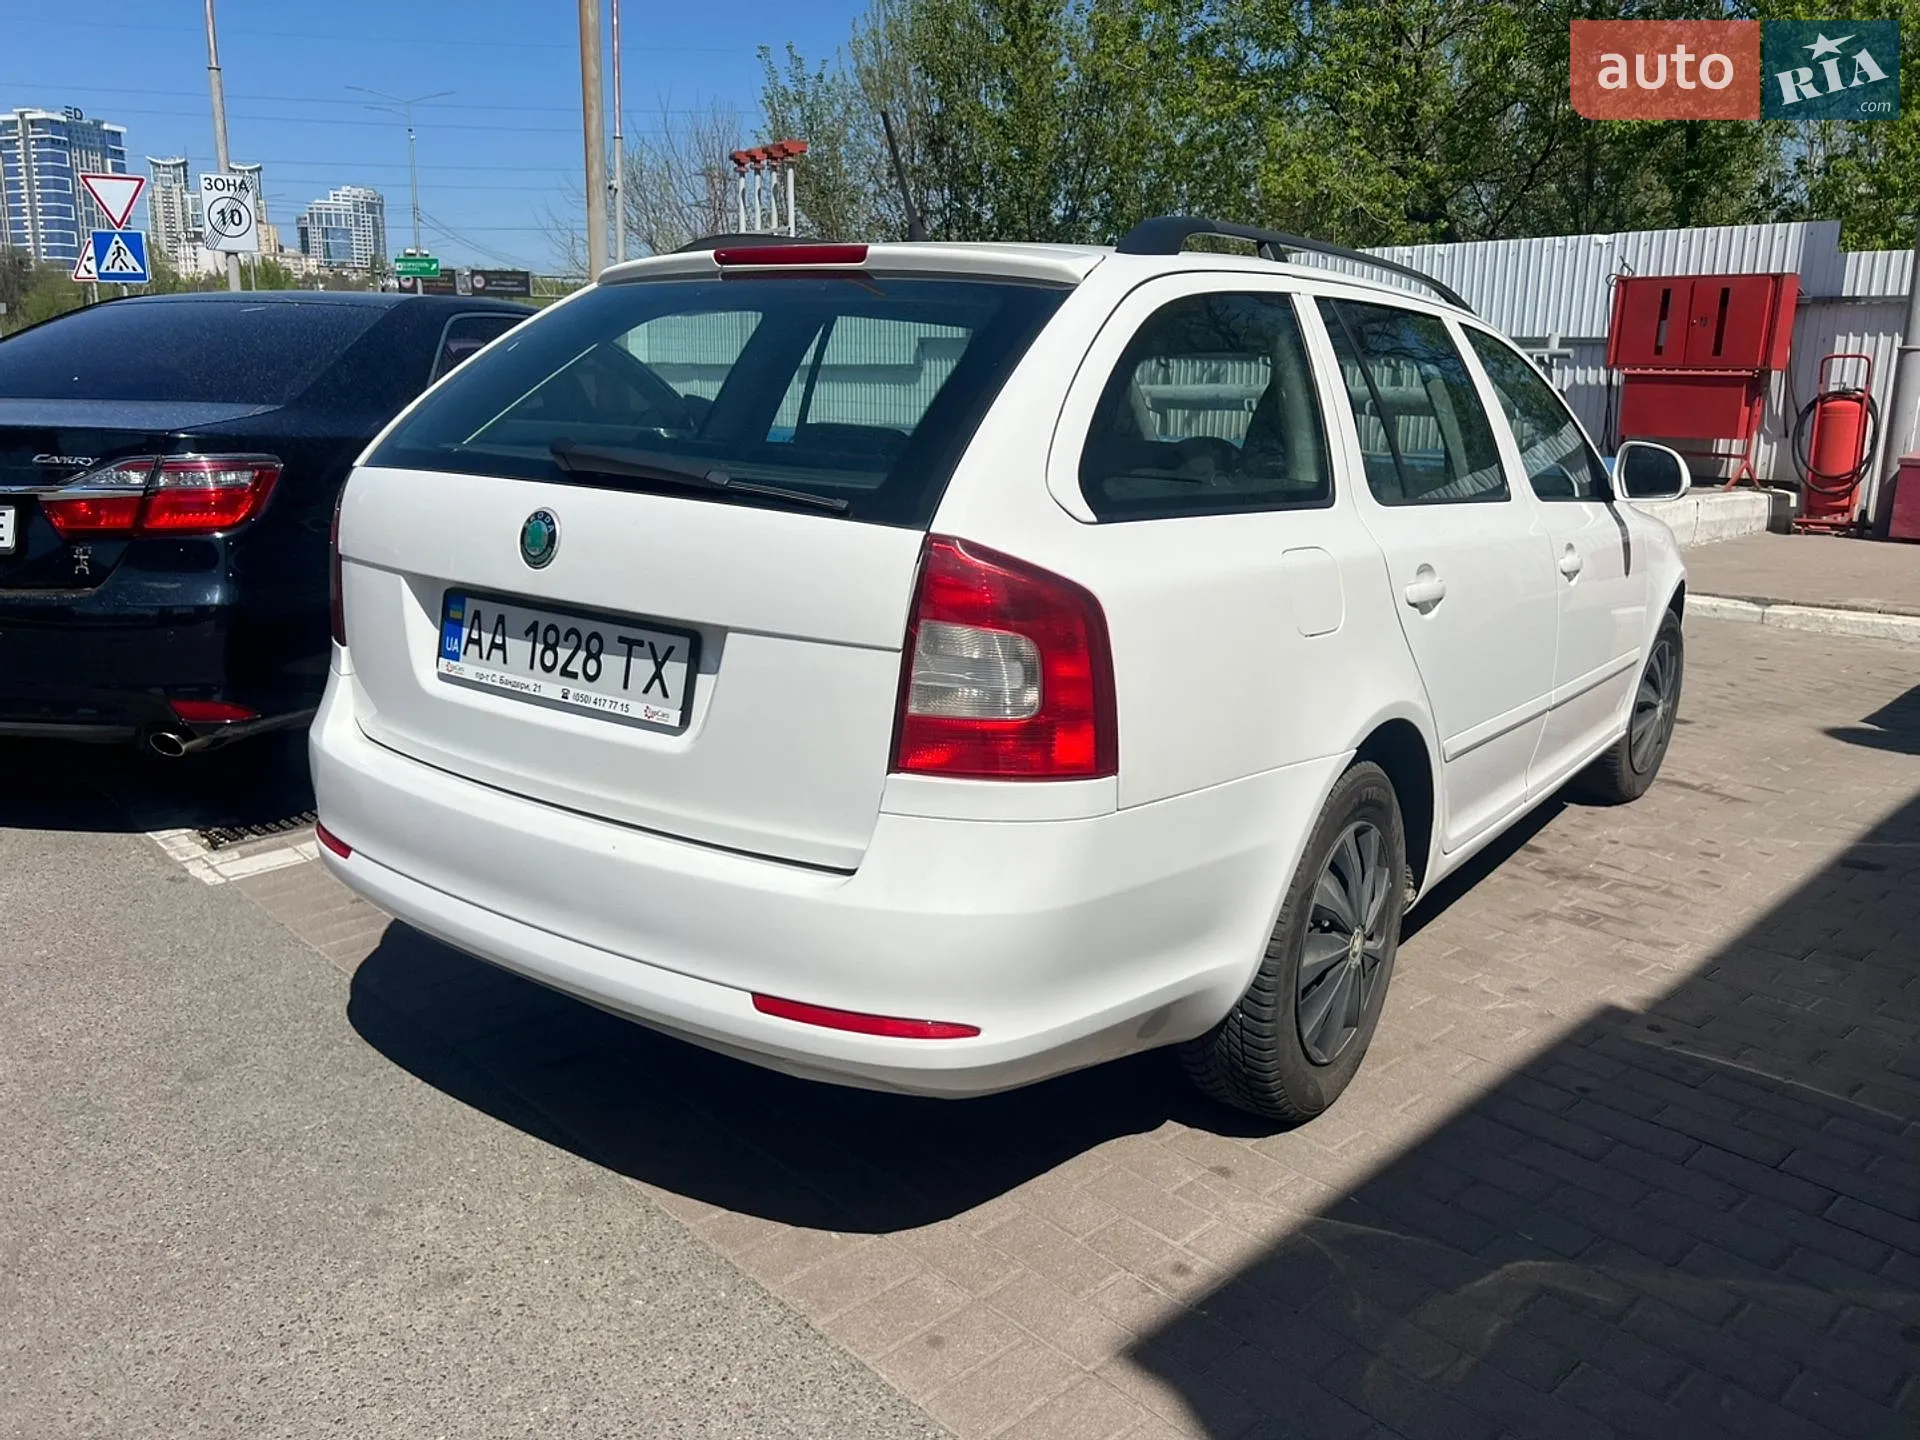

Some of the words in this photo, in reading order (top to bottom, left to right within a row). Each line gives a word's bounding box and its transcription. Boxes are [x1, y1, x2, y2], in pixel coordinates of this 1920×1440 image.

[204, 177, 250, 193] ЗОНА
[216, 208, 243, 226] 10
[445, 636, 460, 653] UA
[462, 609, 508, 665] AA
[524, 620, 604, 683] 1828
[617, 635, 676, 699] TX
[532, 683, 542, 693] 21
[572, 691, 592, 705] (050)
[592, 697, 607, 707] 417
[608, 700, 618, 710] 77
[619, 703, 631, 714] 15
